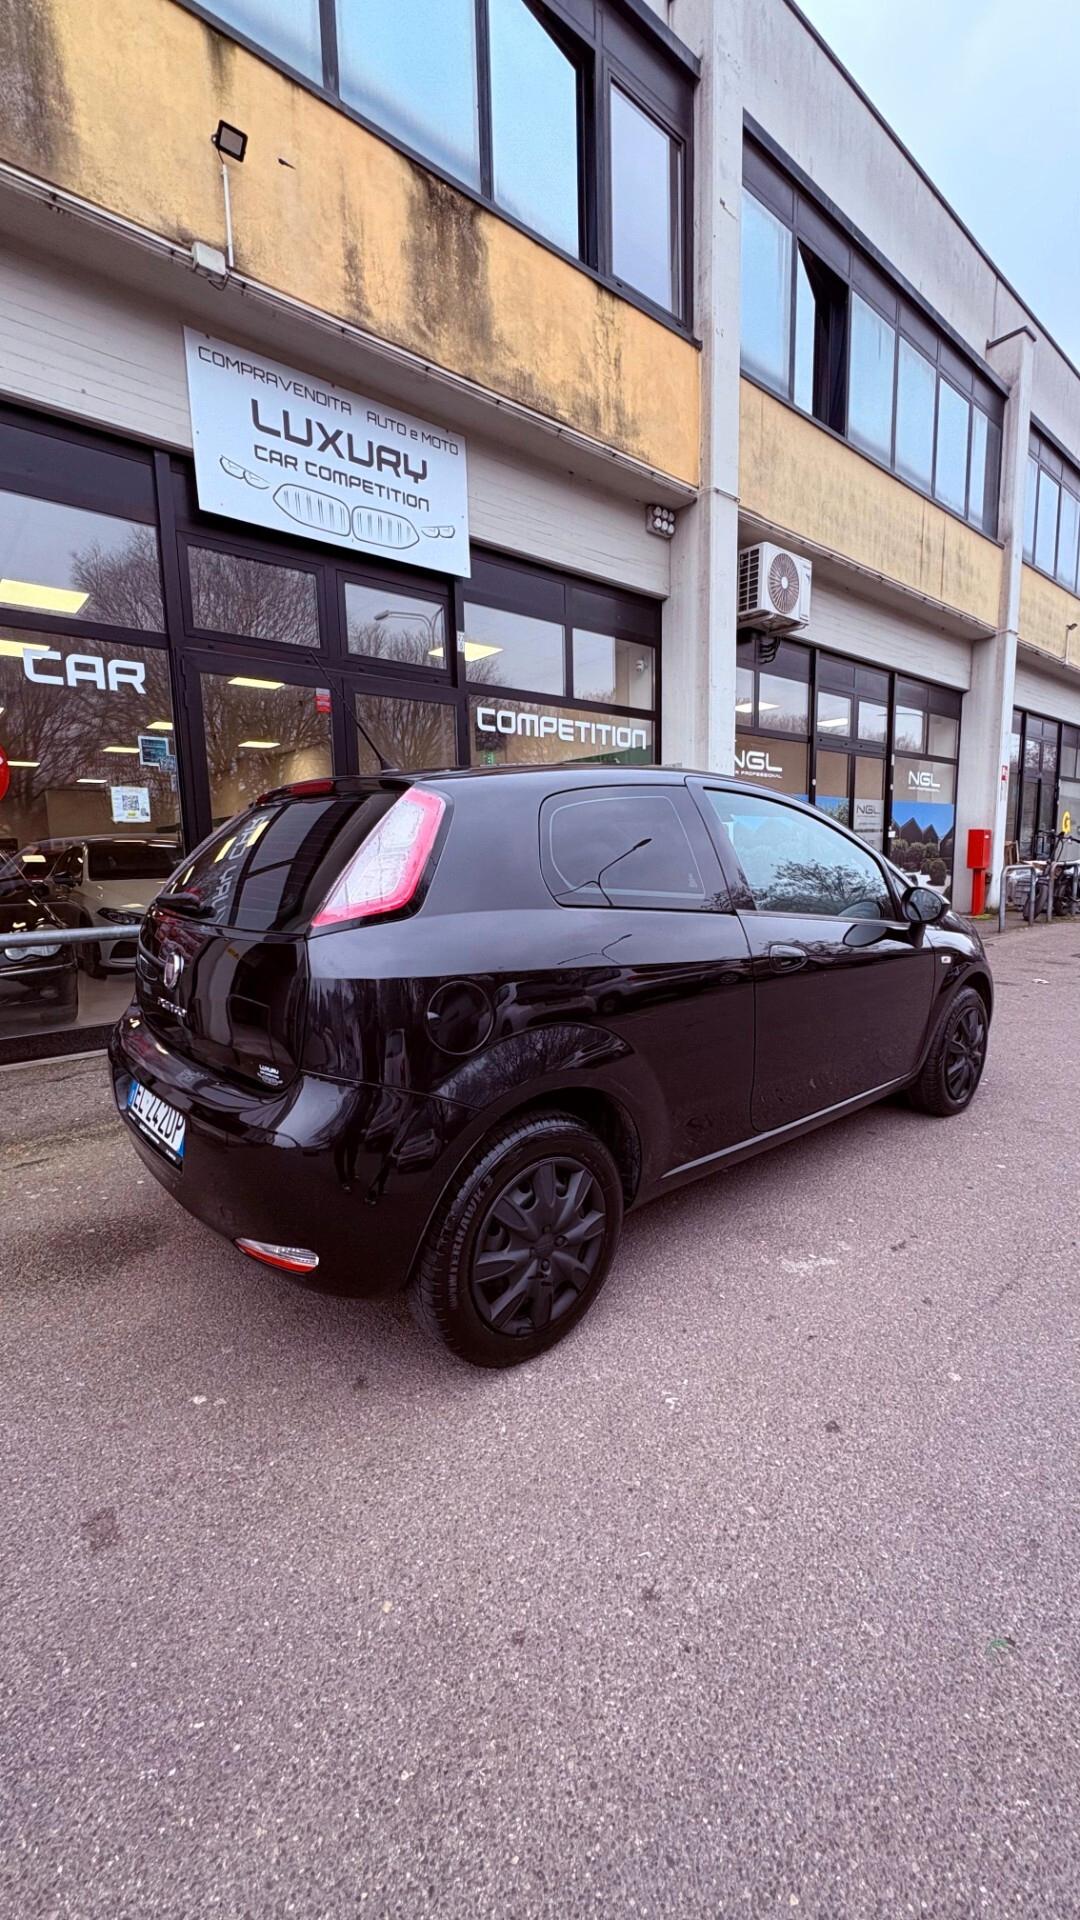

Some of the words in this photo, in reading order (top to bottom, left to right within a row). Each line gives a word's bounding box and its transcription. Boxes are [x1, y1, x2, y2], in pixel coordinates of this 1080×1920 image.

[198, 345, 352, 415] COMPRAVENDITA
[366, 410, 407, 436] AUTO
[410, 429, 418, 441] e
[421, 431, 459, 456] MOTO
[251, 398, 427, 484] LUXURY
[253, 444, 298, 471] CAR
[305, 460, 430, 512] COMPETITION
[22, 648, 146, 694] CAR
[476, 707, 647, 750] COMPETITION
[908, 770, 941, 788] NGL
[856, 804, 880, 815] NGL
